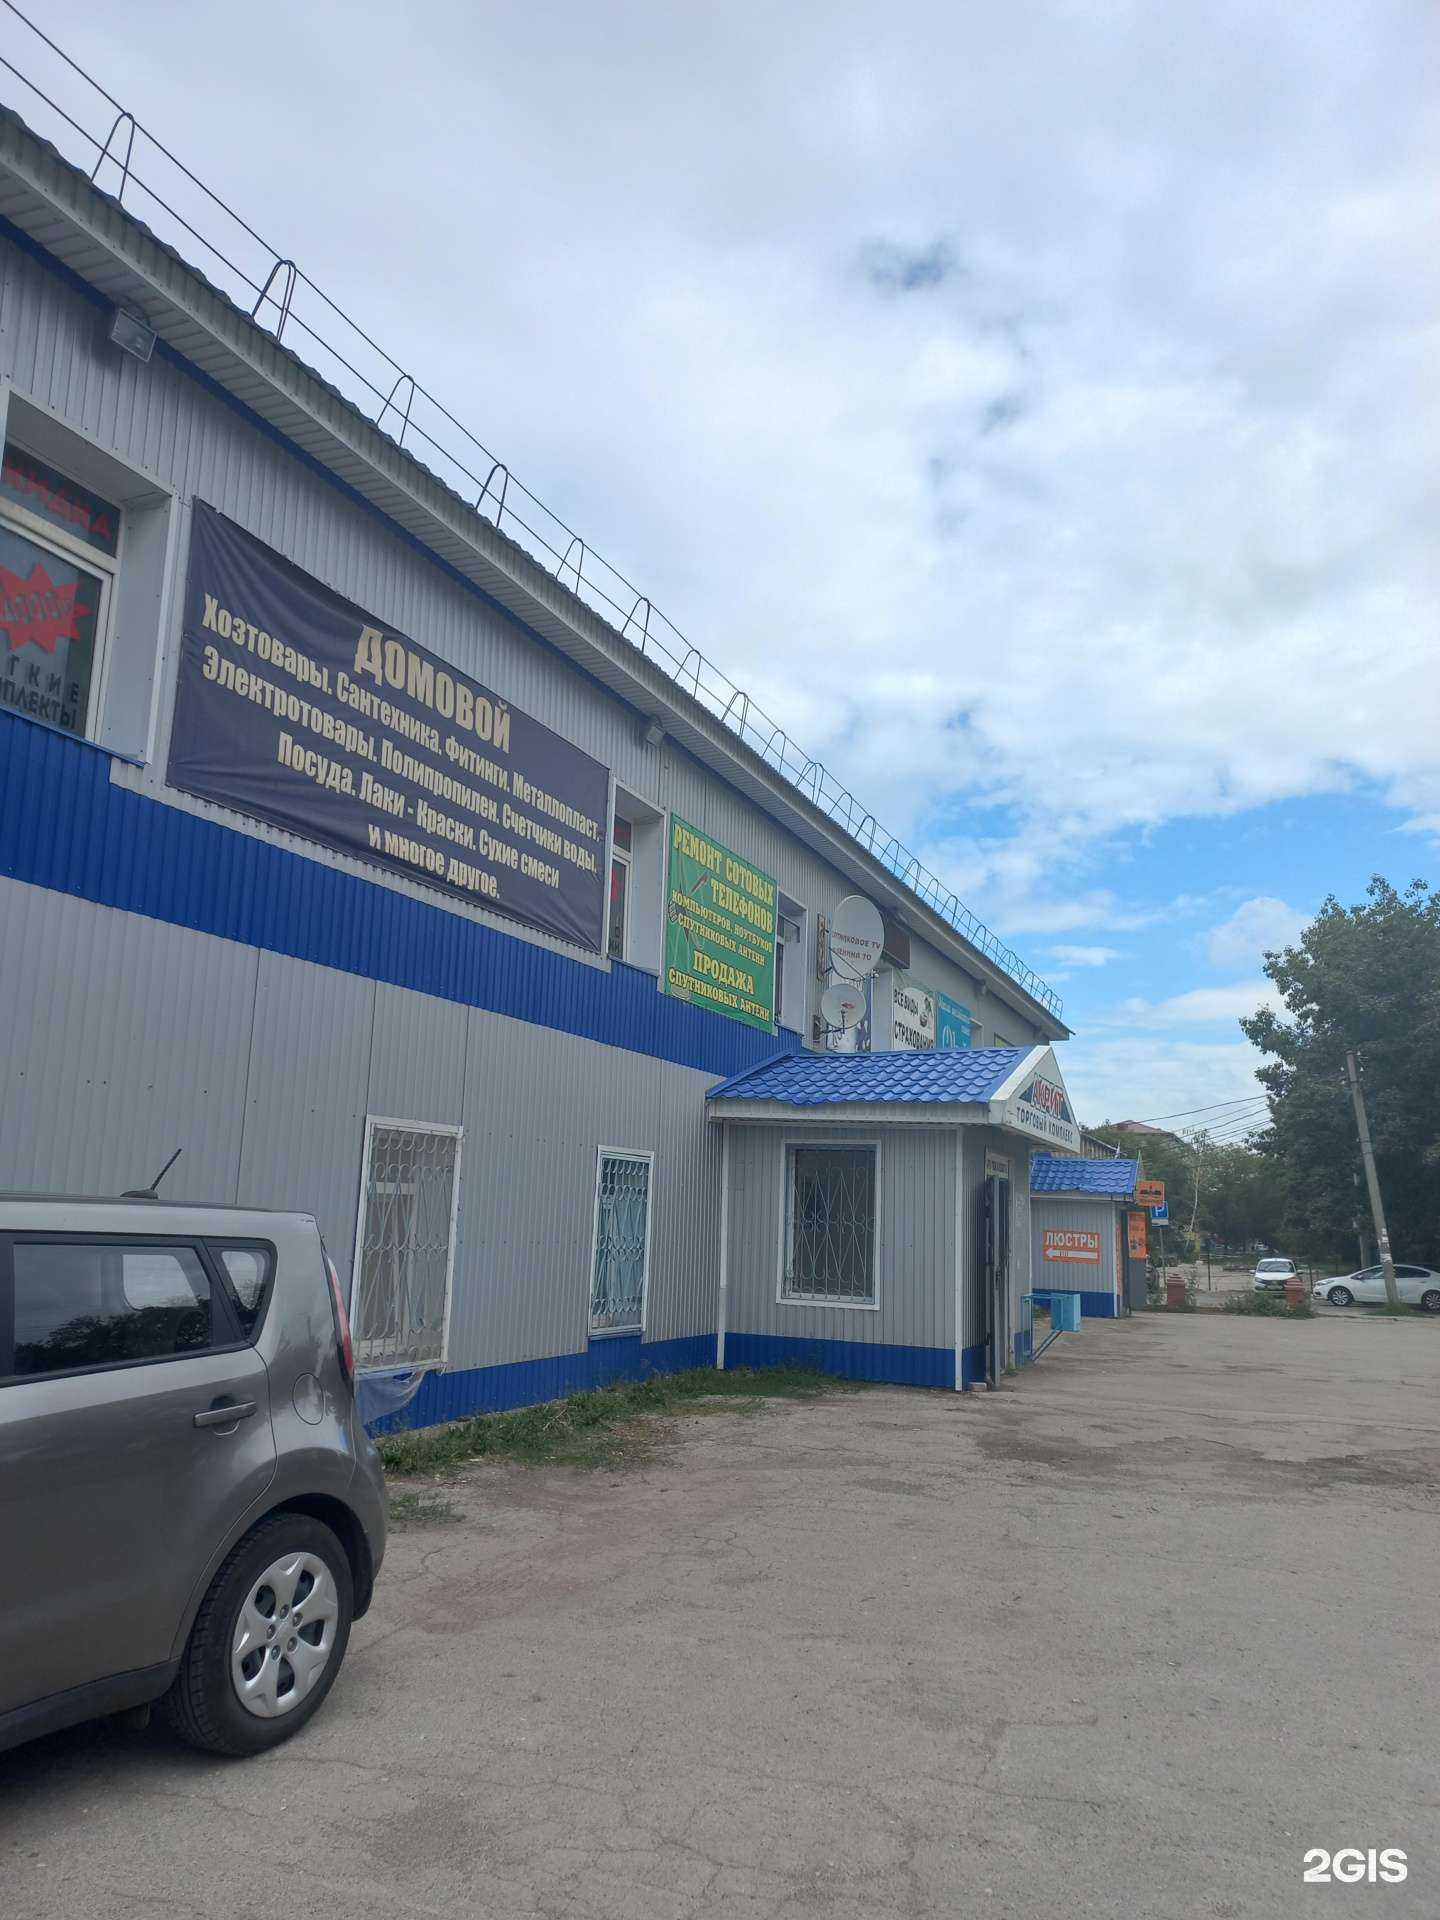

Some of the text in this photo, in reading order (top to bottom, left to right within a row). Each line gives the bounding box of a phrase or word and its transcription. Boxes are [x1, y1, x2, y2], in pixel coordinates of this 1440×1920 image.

[202, 593, 334, 694] Хозтовары.
[0, 678, 77, 729] ПЛЕКТЫ
[354, 624, 511, 753] ДОМОВОЙ
[203, 645, 377, 763] Электротовары.
[381, 738, 499, 824] Полипропилен.
[503, 803, 561, 856] Счетчики
[278, 731, 356, 796] Посуда.
[359, 772, 405, 818] Лаки
[416, 799, 476, 850] Краски.
[479, 829, 518, 870] Сухие
[521, 853, 559, 888] смеси
[384, 831, 445, 875] многое
[447, 857, 500, 899] другое.
[674, 824, 721, 875] РЕМОНТ
[726, 858, 774, 906] СОТОВЫХ
[711, 879, 773, 934] ТЕЛЕФОНОВ
[678, 912, 766, 966] СПУТНИКОВЫХ АНТЕНН
[669, 968, 770, 1021] СПУТНИКОВЫХ АНТЕНН
[693, 950, 754, 995] ПРОДАЖА
[1046, 1231, 1098, 1248] ЛЮСТРЫ
